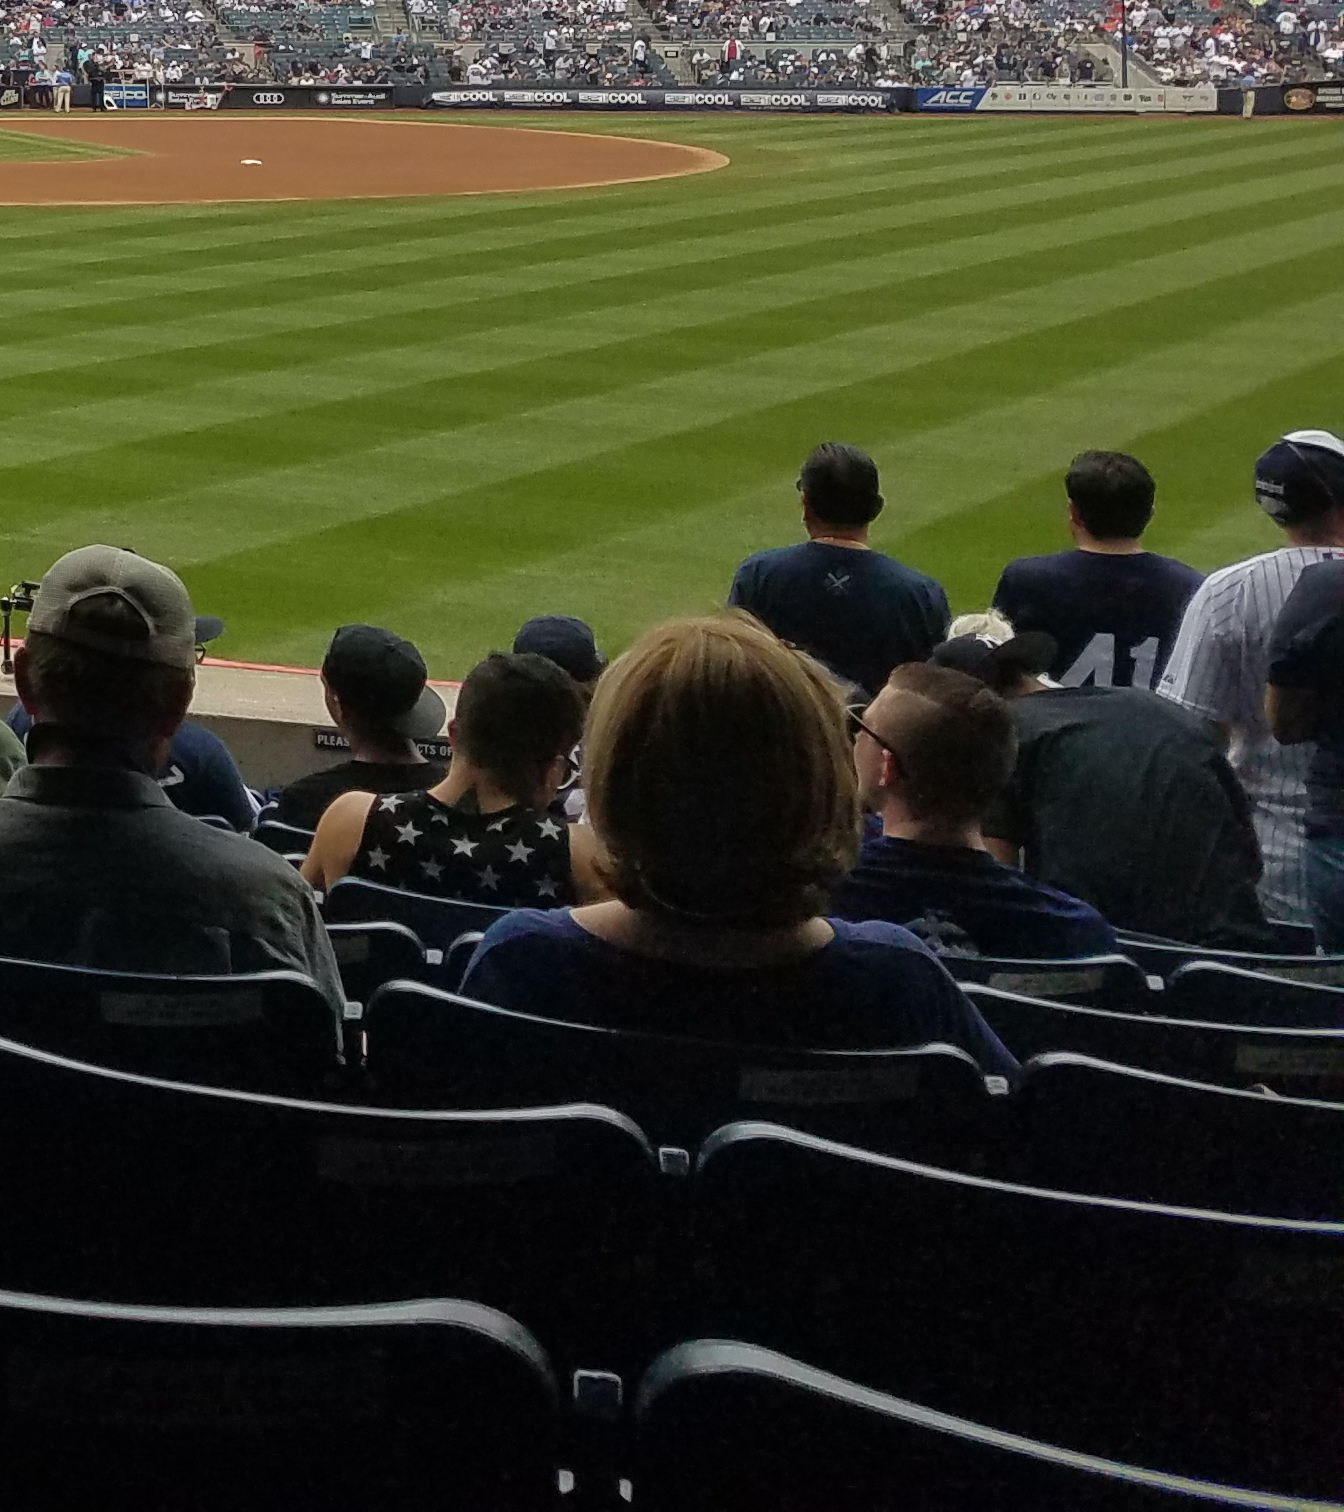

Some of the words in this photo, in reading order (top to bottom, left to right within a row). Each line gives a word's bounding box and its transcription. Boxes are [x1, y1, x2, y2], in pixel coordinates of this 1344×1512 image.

[925, 91, 976, 106] ACC
[1059, 631, 1160, 689] 41
[317, 734, 351, 748] PLEAS
